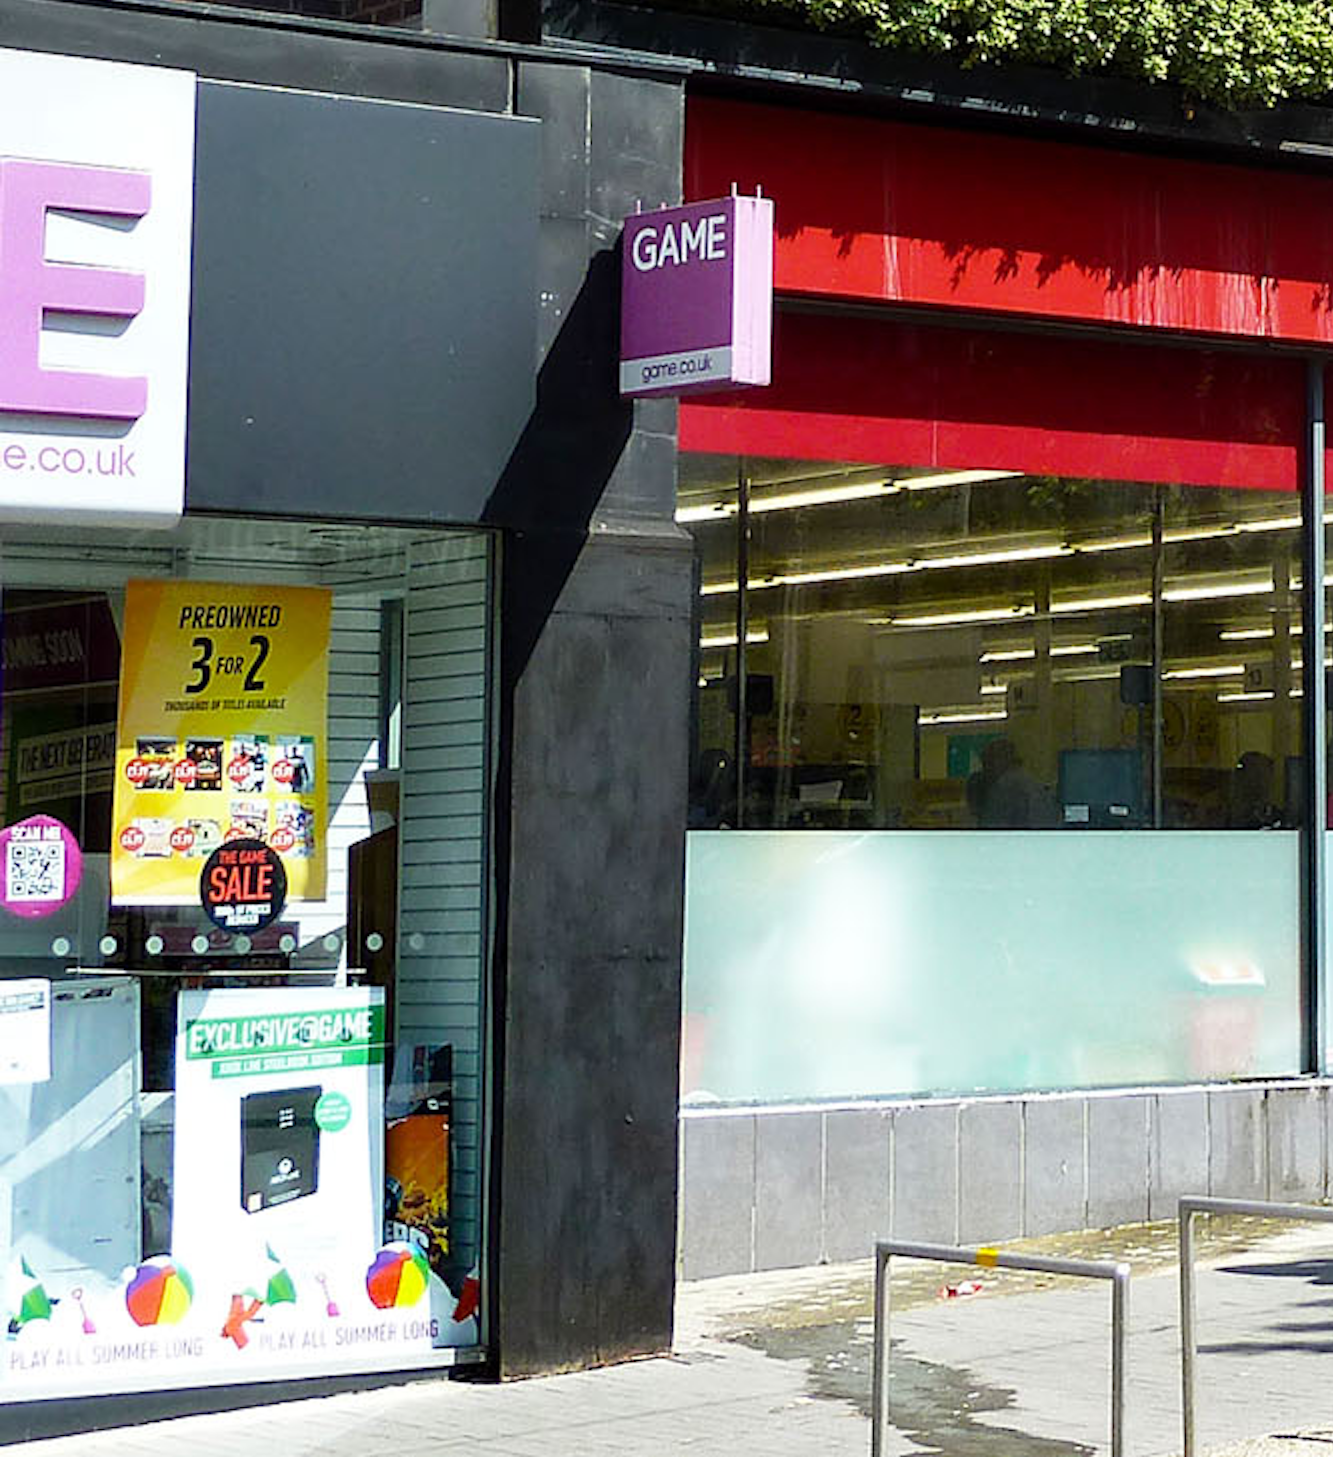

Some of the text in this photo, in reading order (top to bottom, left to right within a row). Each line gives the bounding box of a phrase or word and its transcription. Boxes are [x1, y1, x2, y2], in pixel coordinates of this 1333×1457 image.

[633, 214, 726, 271] GAME
[642, 354, 713, 384] game.co.uk
[179, 605, 281, 630] PREOWNED
[185, 634, 270, 694] 3 FOR 2
[11, 826, 61, 840] SCAN ME
[219, 848, 268, 864] THE GAME
[208, 864, 274, 903] SALE
[190, 1009, 374, 1053] EXCLUSIVE@GAME
[259, 1318, 439, 1352] PLAY ALL SUMMER LONG
[9, 1336, 204, 1371] PLAY ALL SUMMER LONG
